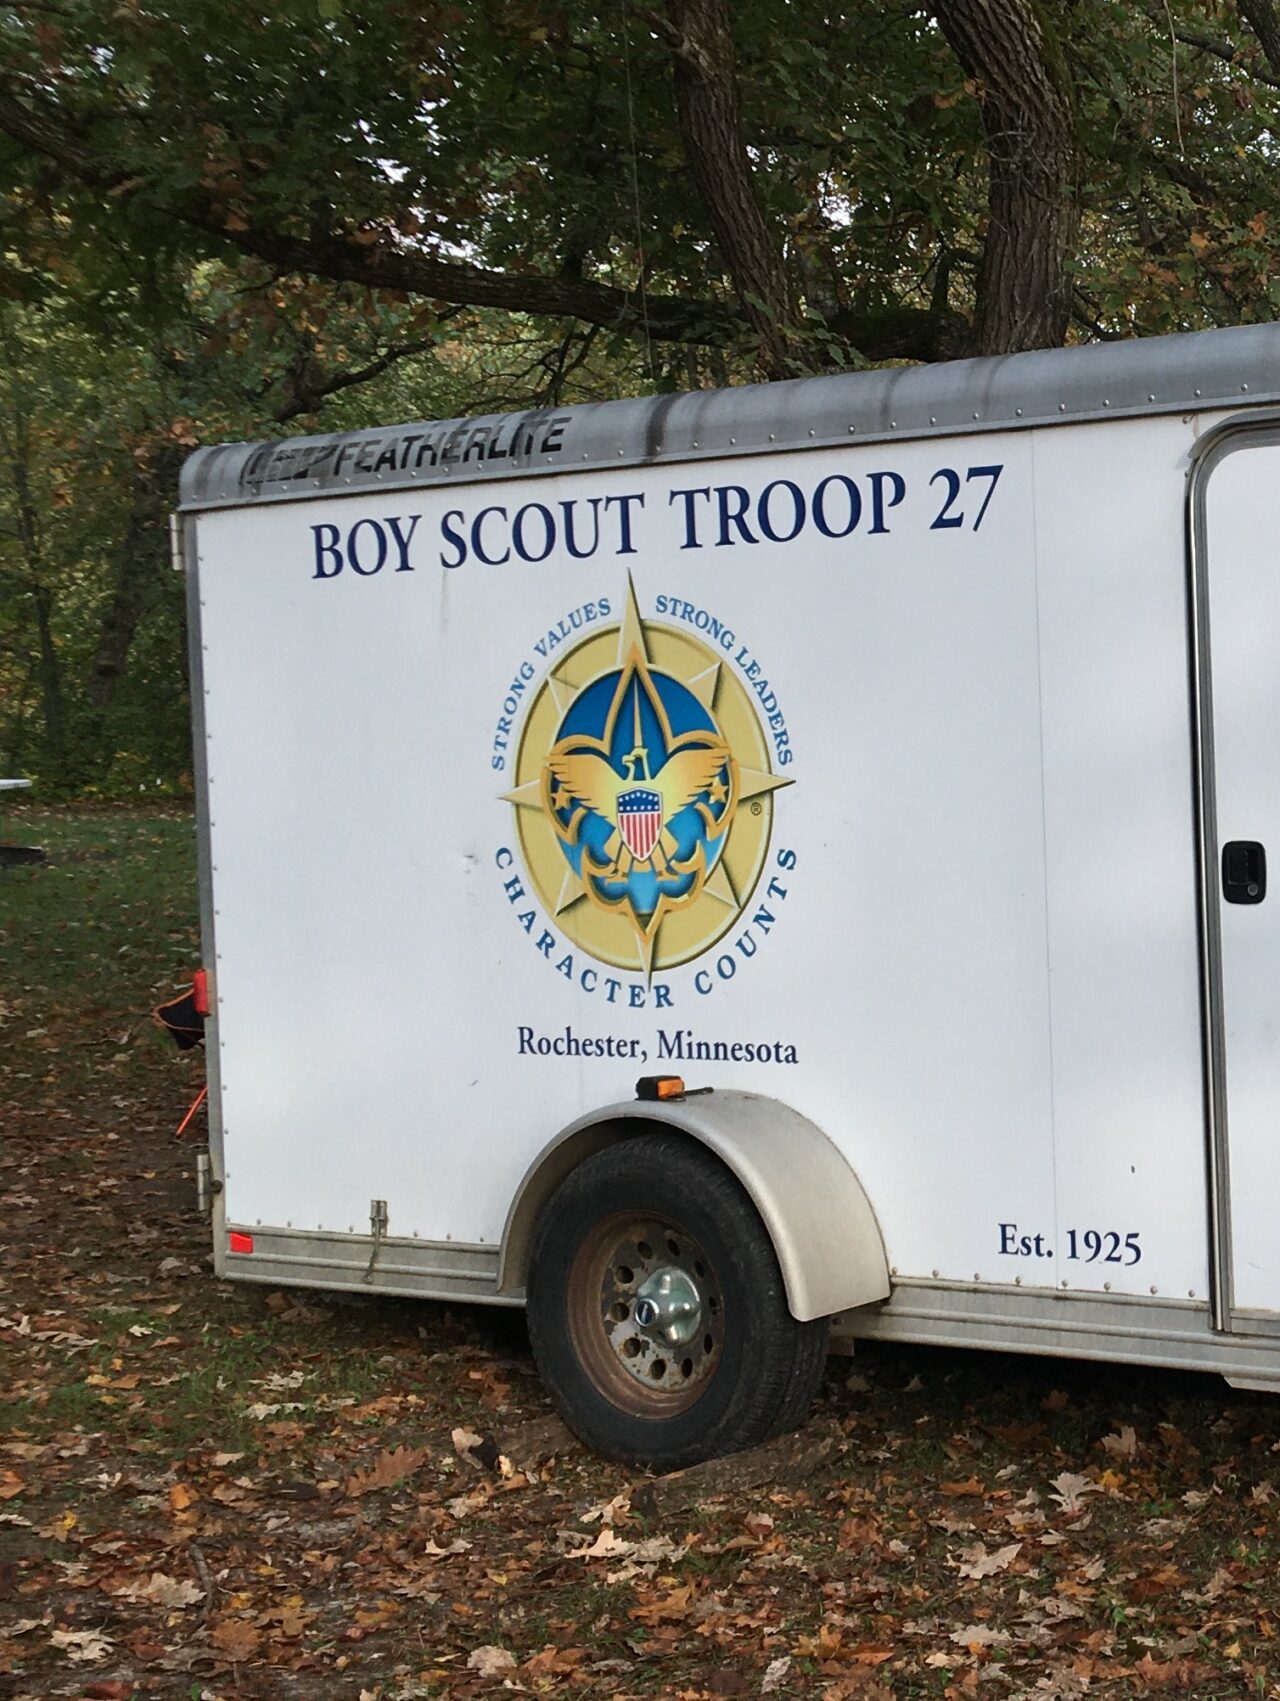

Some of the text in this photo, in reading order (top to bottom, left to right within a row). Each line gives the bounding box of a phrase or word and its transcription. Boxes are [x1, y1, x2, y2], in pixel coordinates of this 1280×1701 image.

[311, 464, 1005, 580] BOY SCOUT TROOP 27
[492, 598, 611, 771] STRONG VALUES
[655, 594, 793, 766] STRONG LEADERS
[495, 847, 797, 1008] CHARACTER COUNTS
[517, 1025, 800, 1065] Rochester, Minnesota
[997, 1222, 1142, 1267] Est. 1925
